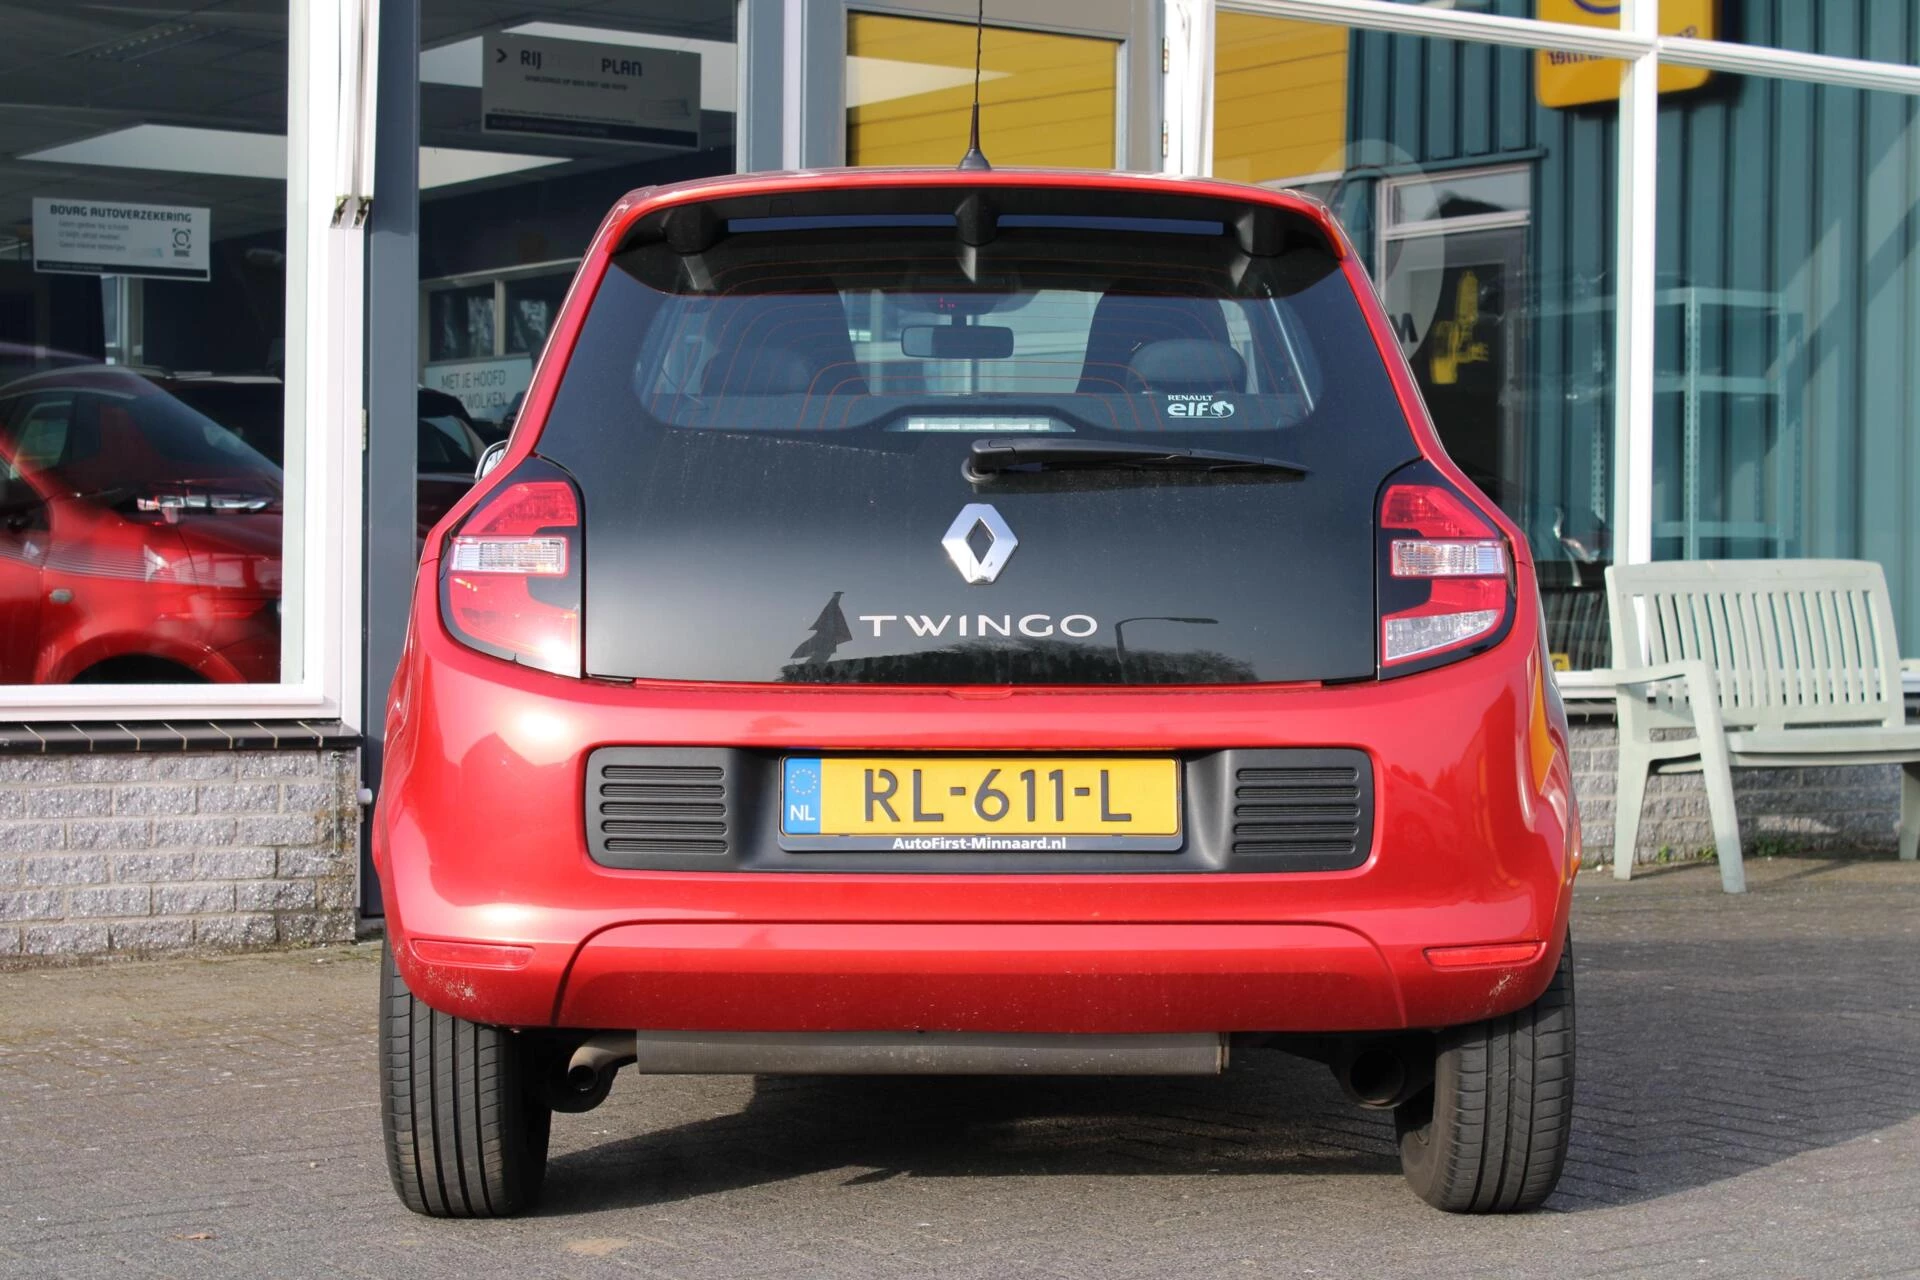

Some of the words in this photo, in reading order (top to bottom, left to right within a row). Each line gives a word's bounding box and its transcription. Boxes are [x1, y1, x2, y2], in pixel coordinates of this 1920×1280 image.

[520, 49, 542, 70] RIJ
[601, 57, 643, 77] PLAN
[50, 204, 87, 217] BOVAG
[90, 206, 192, 223] AUTOVERZEKERING
[441, 373, 460, 390] MET
[473, 369, 506, 388] HOOFD
[467, 391, 507, 409] WOLKEN
[1167, 394, 1213, 402] RENAULT
[1167, 401, 1209, 416] elf
[859, 614, 1098, 637] TWINGO
[864, 768, 1132, 822] RL-611-L
[790, 805, 816, 822] NL
[892, 836, 1067, 851] AutoFirst-Minnaard.nl
